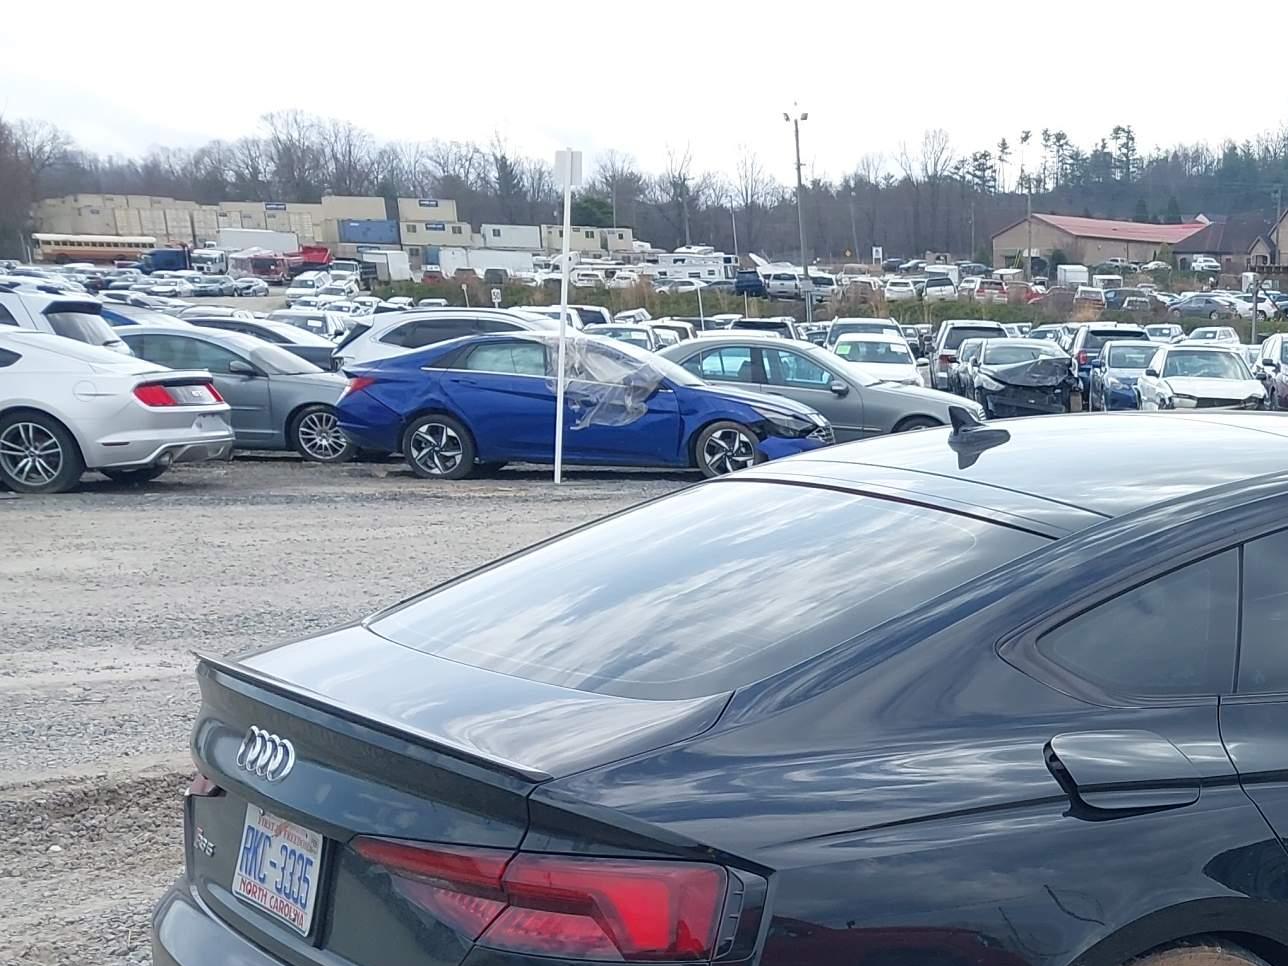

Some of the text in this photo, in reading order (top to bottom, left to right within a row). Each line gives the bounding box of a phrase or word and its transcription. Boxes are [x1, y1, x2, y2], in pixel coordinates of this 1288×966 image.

[240, 825, 314, 909] RKC-3335
[239, 878, 305, 928] NORTH CAROLINA
